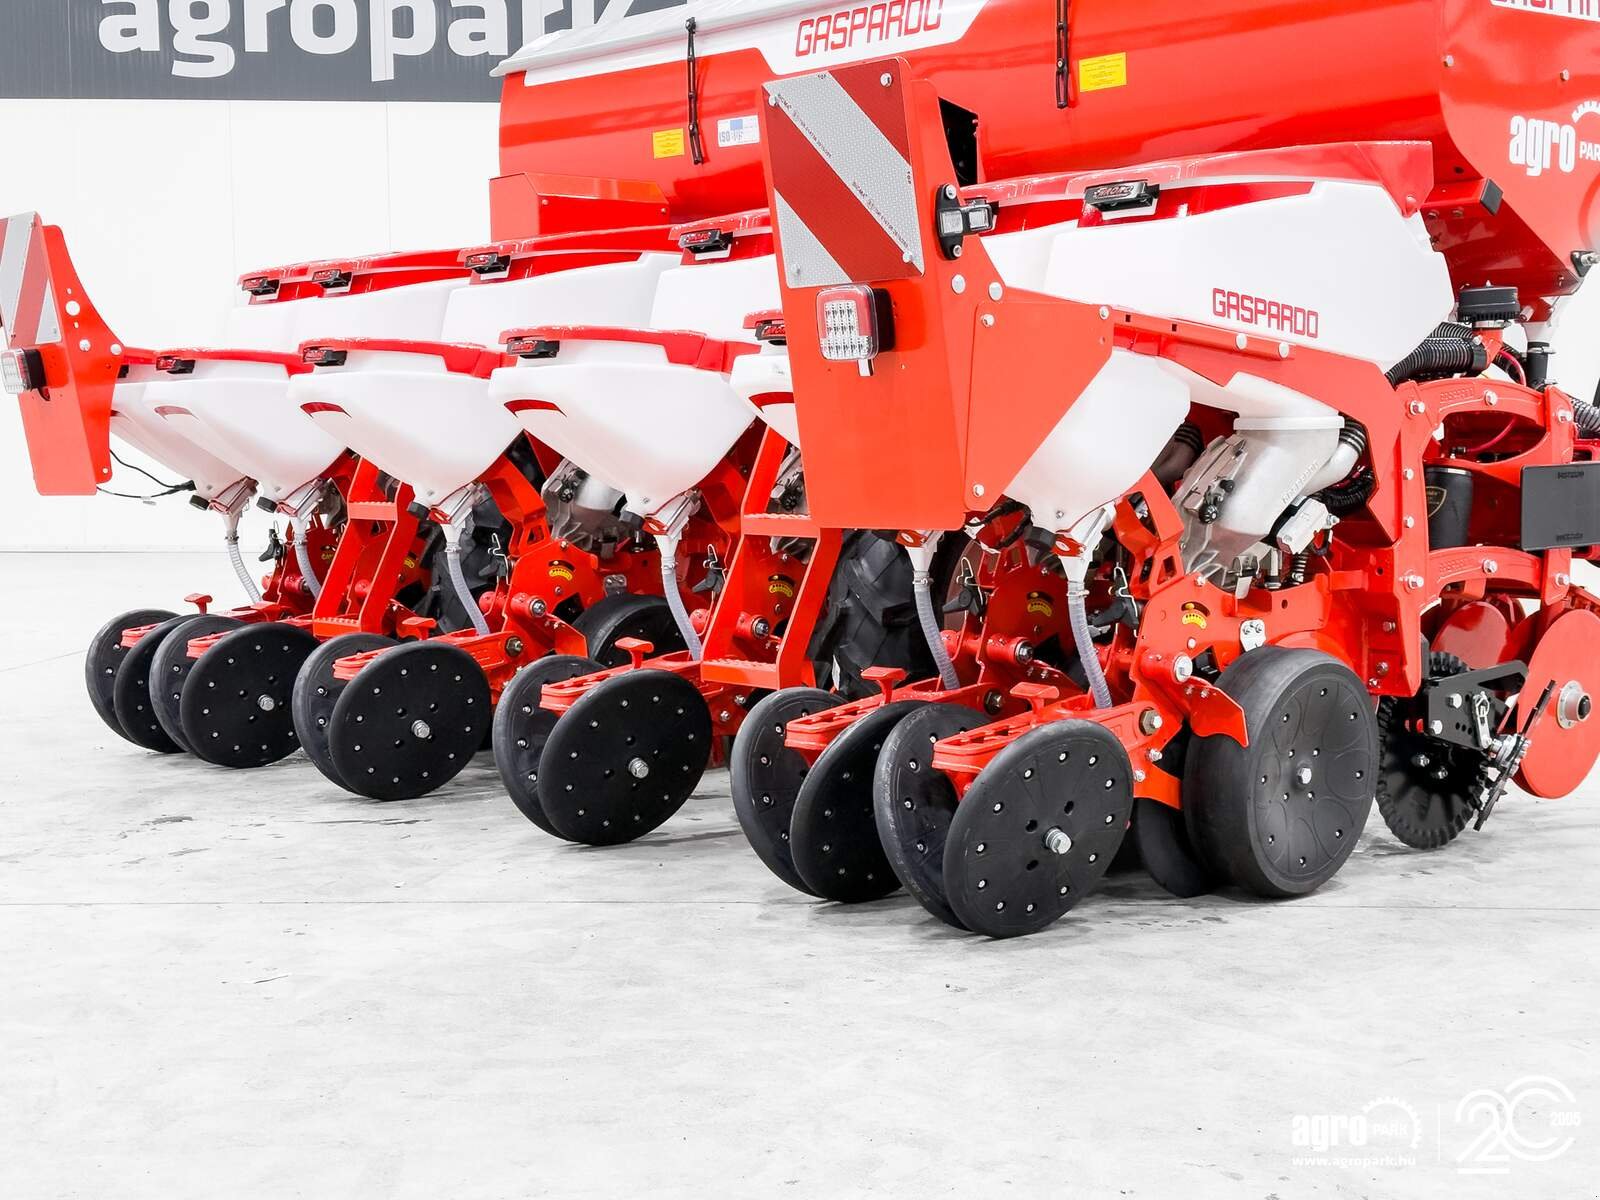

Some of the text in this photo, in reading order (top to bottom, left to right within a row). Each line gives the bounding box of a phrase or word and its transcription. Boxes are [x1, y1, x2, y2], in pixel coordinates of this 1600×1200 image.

[795, 0, 943, 57] GASPARDO
[1509, 115, 1576, 176] agro
[1213, 287, 1318, 338] GASPARDO
